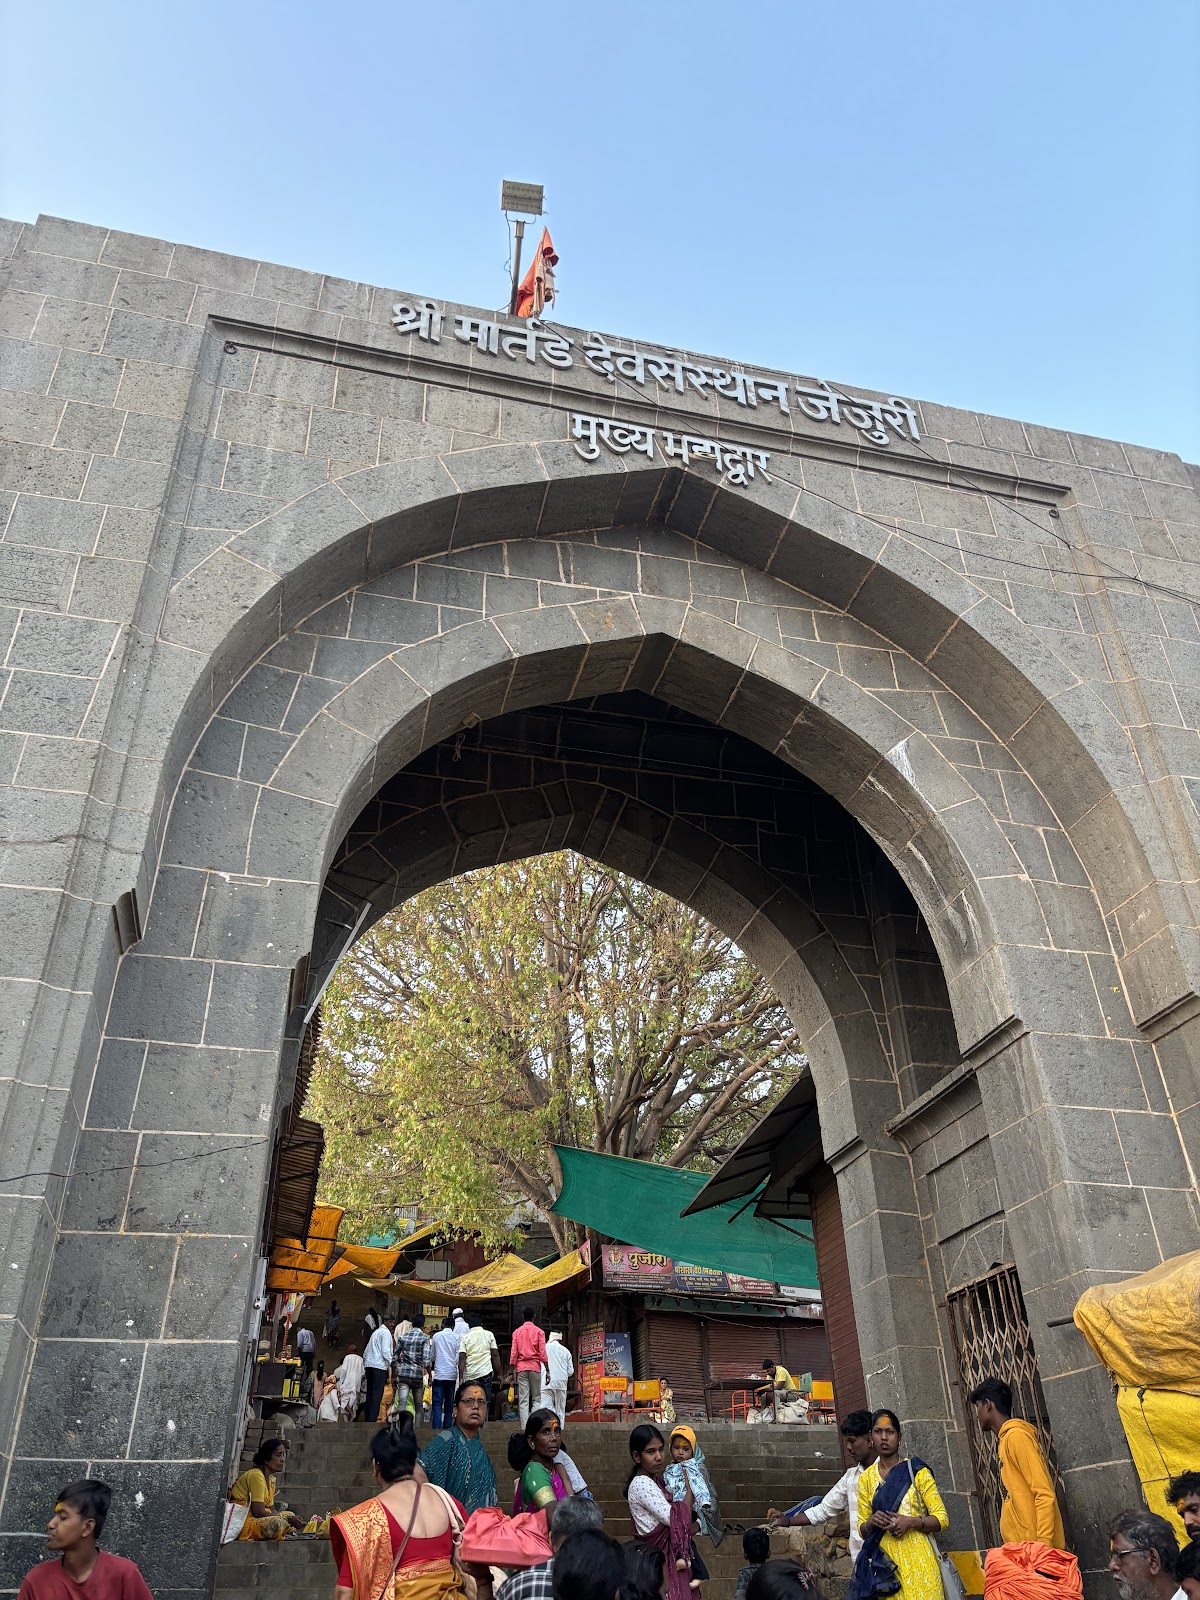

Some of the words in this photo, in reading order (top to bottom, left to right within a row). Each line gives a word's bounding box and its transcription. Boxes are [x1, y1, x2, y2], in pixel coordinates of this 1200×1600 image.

[390, 300, 445, 345] श्री
[795, 379, 921, 447] जेजुरी
[572, 412, 656, 462] मुख्य
